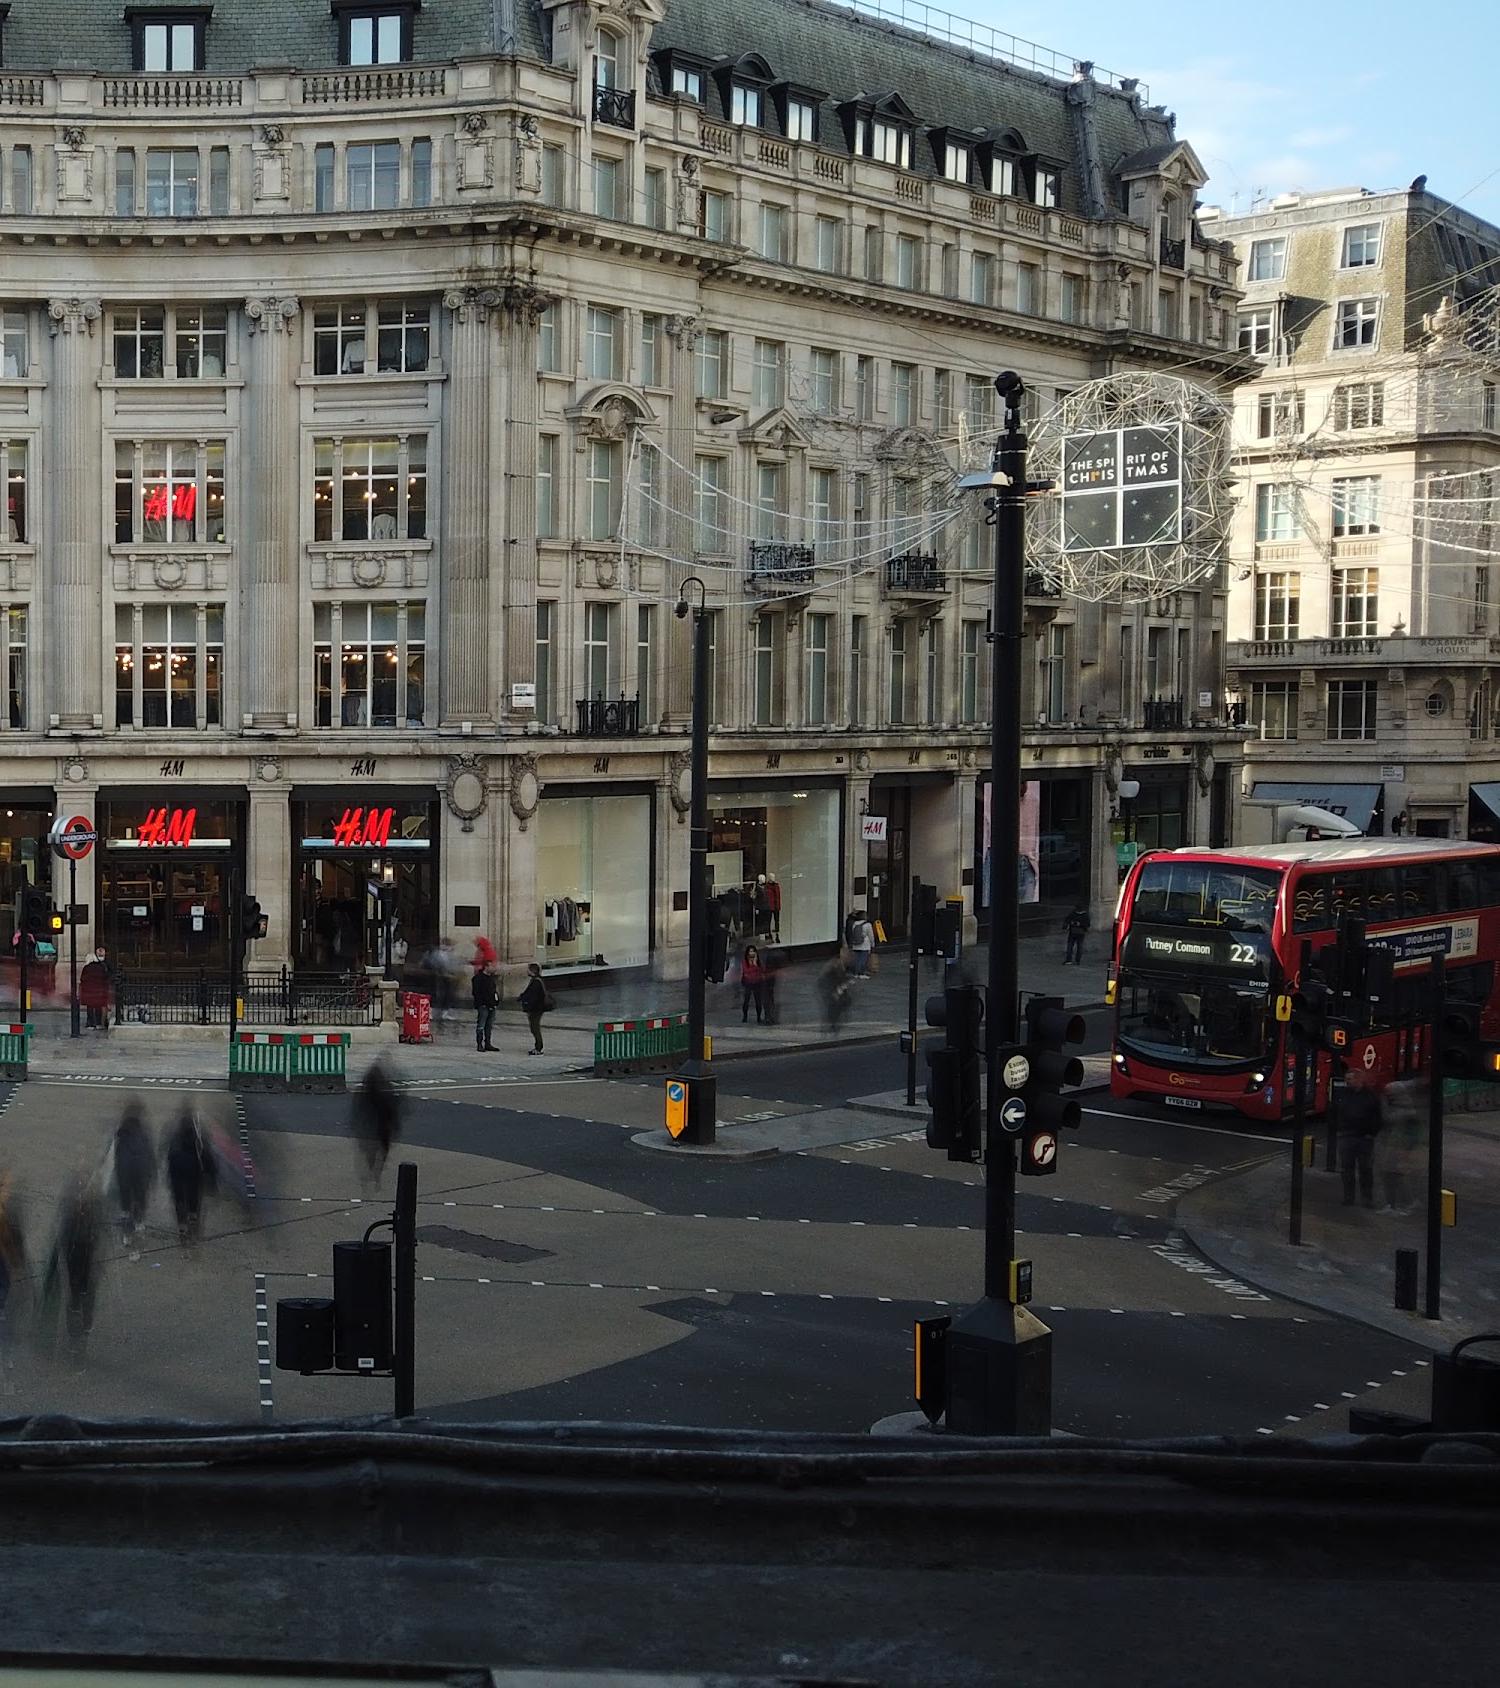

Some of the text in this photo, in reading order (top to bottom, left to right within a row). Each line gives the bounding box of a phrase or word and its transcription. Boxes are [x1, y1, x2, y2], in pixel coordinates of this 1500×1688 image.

[1071, 460, 1093, 471] THE
[1151, 451, 1169, 462] OF
[160, 760, 185, 777] H&M
[351, 760, 377, 776] H&M
[138, 808, 197, 848] H&M
[333, 808, 394, 848] H&M
[864, 821, 883, 835] H&M
[60, 833, 97, 843] UNDERGROUND
[1145, 938, 1211, 955] Putney Common
[1230, 944, 1255, 963] 22
[1008, 1059, 1027, 1069] Except
[1010, 1067, 1027, 1076] buses
[60, 1074, 204, 1086] LOOK RIGHT
[1169, 1073, 1186, 1085] Go
